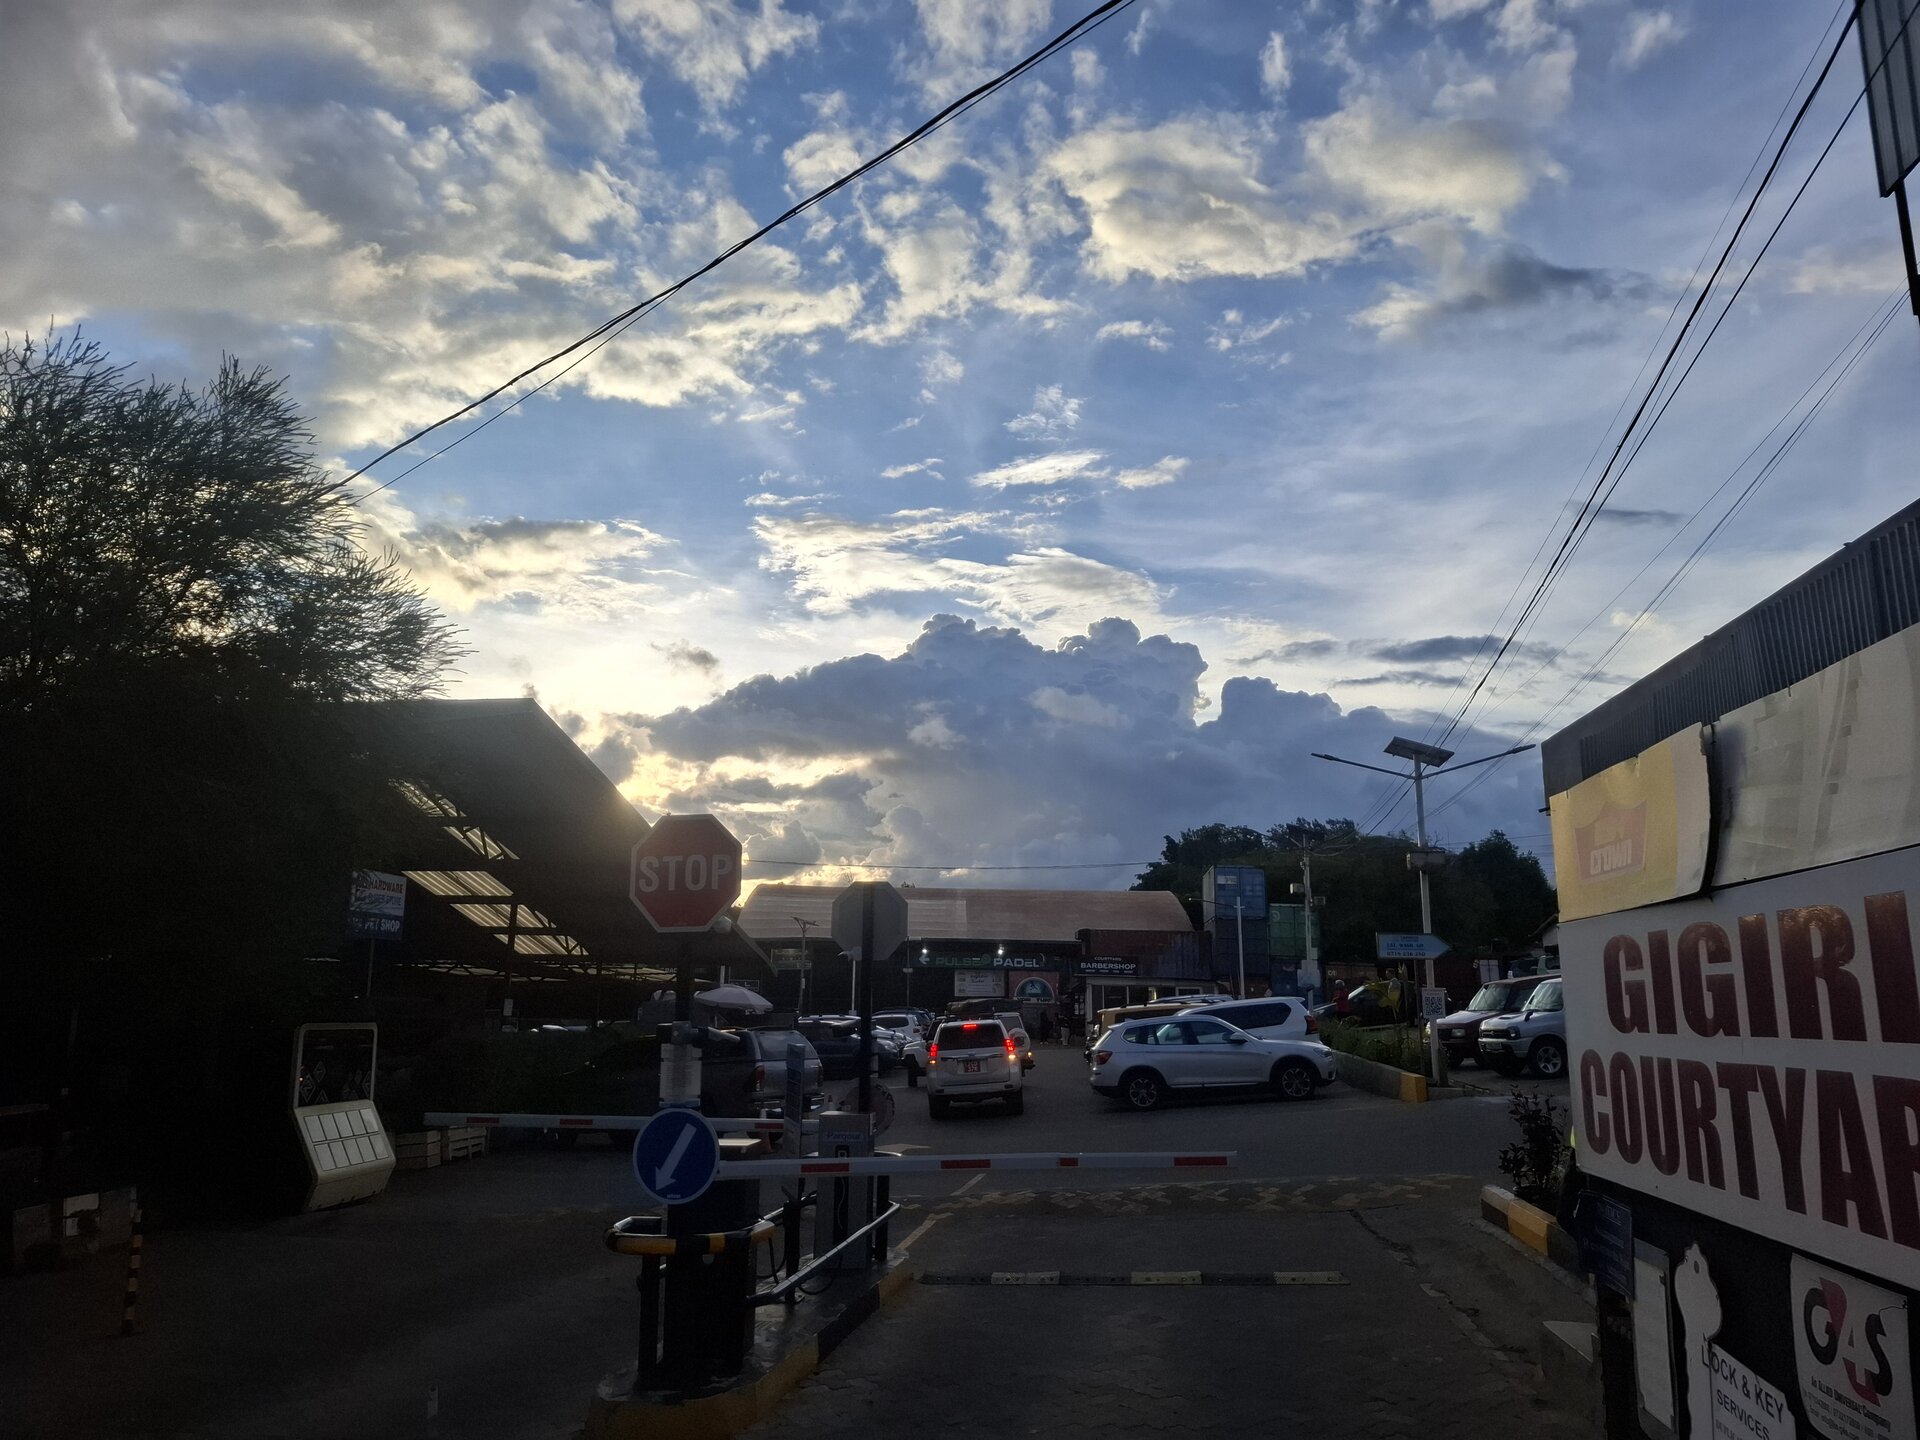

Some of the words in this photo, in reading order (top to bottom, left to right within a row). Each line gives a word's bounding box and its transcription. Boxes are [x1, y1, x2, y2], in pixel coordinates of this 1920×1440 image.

[639, 854, 733, 892] STOP
[380, 919, 400, 933] SHOP
[935, 956, 982, 966] PULSE
[993, 957, 1040, 968] PADEL
[1080, 962, 1136, 970] BARBERSHOP
[1603, 890, 1920, 1043] GIGIRI
[1804, 1277, 1893, 1407] G4S
[1701, 1344, 1738, 1390] LOCK
[1742, 1374, 1751, 1400] &
[1754, 1383, 1784, 1423] KEY
[1717, 1389, 1769, 1440] SERVICES
